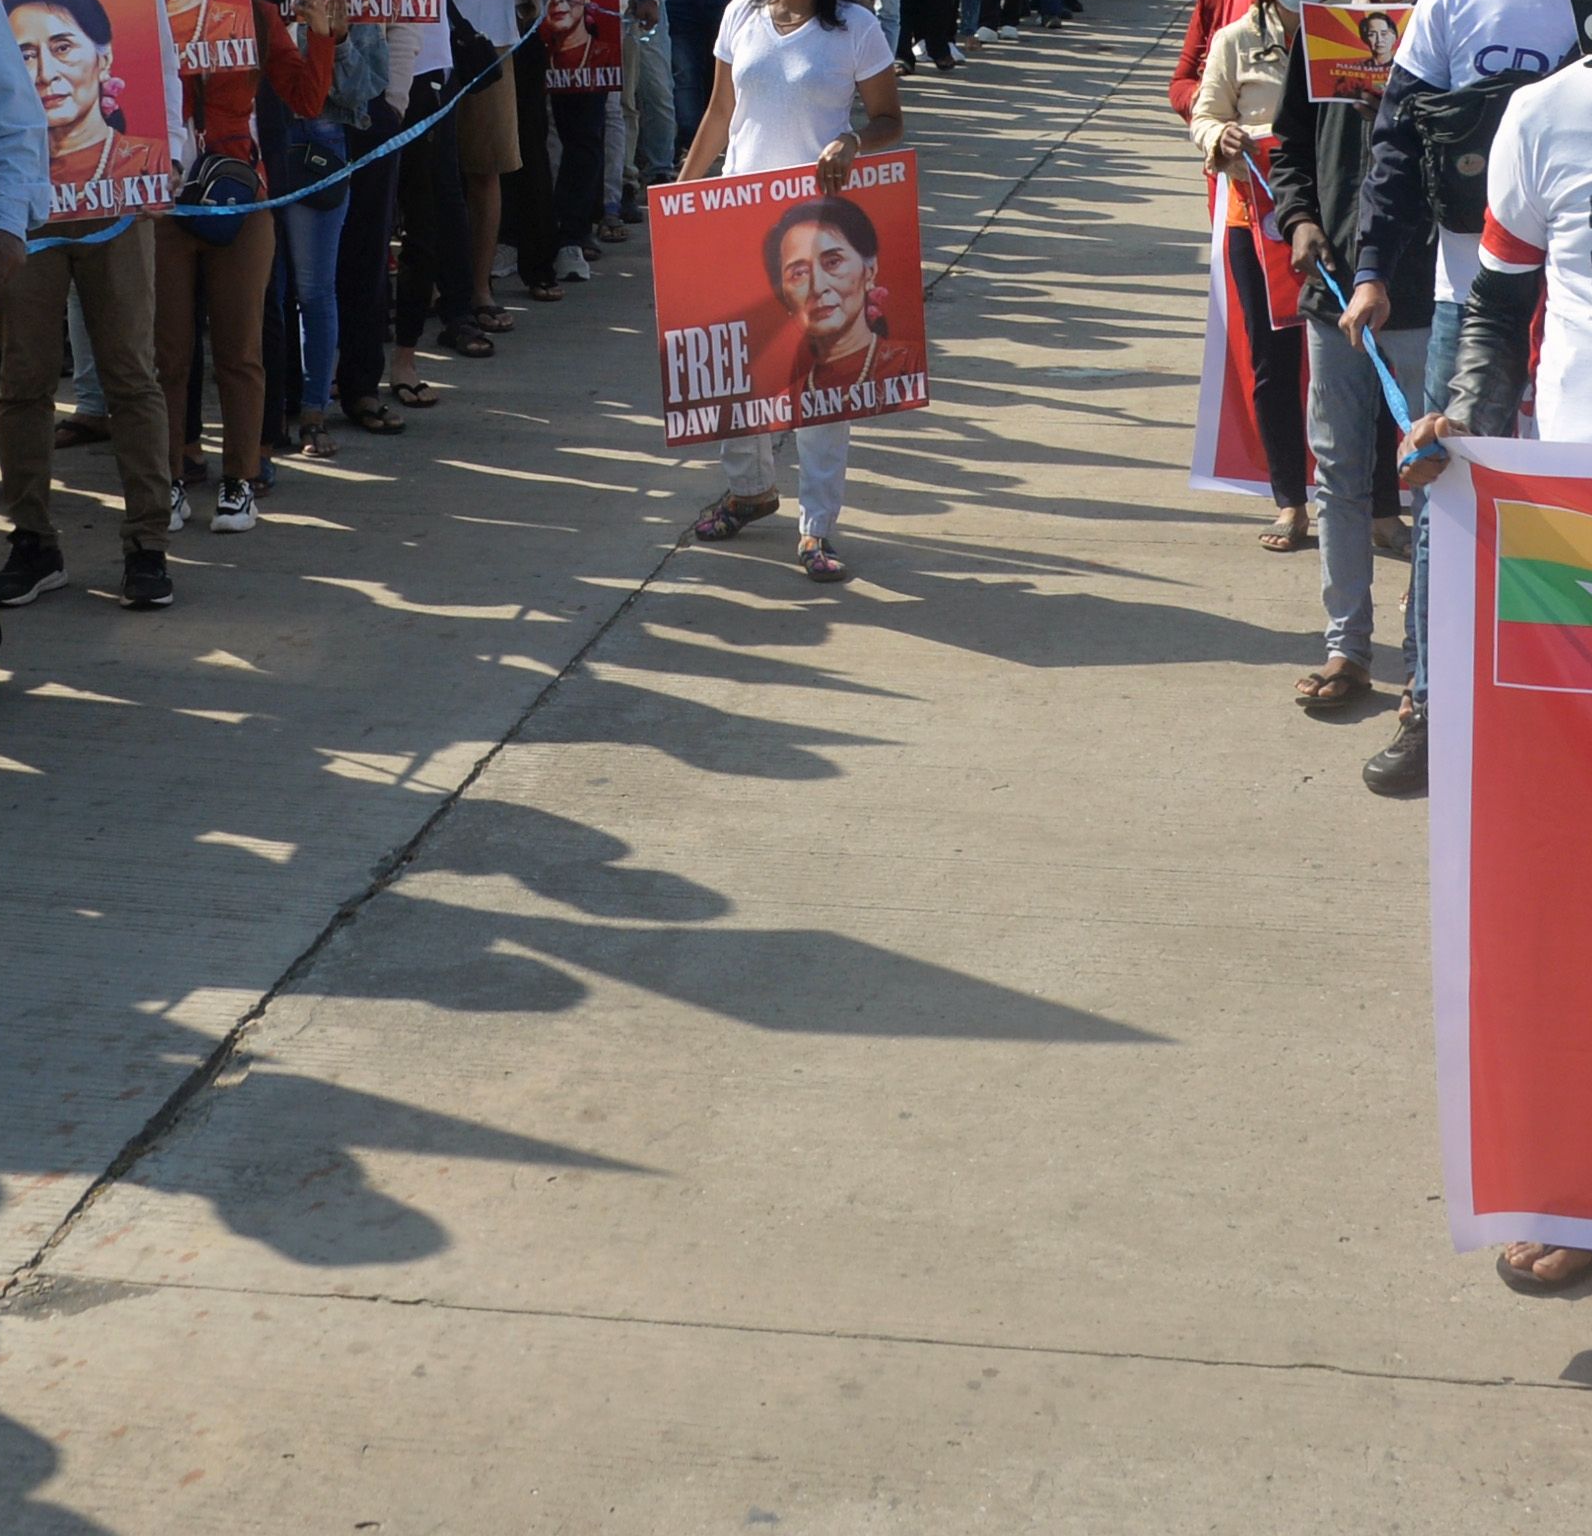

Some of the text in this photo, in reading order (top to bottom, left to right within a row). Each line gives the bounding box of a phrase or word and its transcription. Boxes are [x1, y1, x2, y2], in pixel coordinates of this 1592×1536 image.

[216, 38, 257, 69] KYI
[596, 66, 622, 87] KYI
[122, 173, 172, 206] KYI
[660, 175, 816, 217] WE WANT OUR
[664, 321, 751, 404] FREE
[667, 372, 927, 440] DAW AUNG KYI
